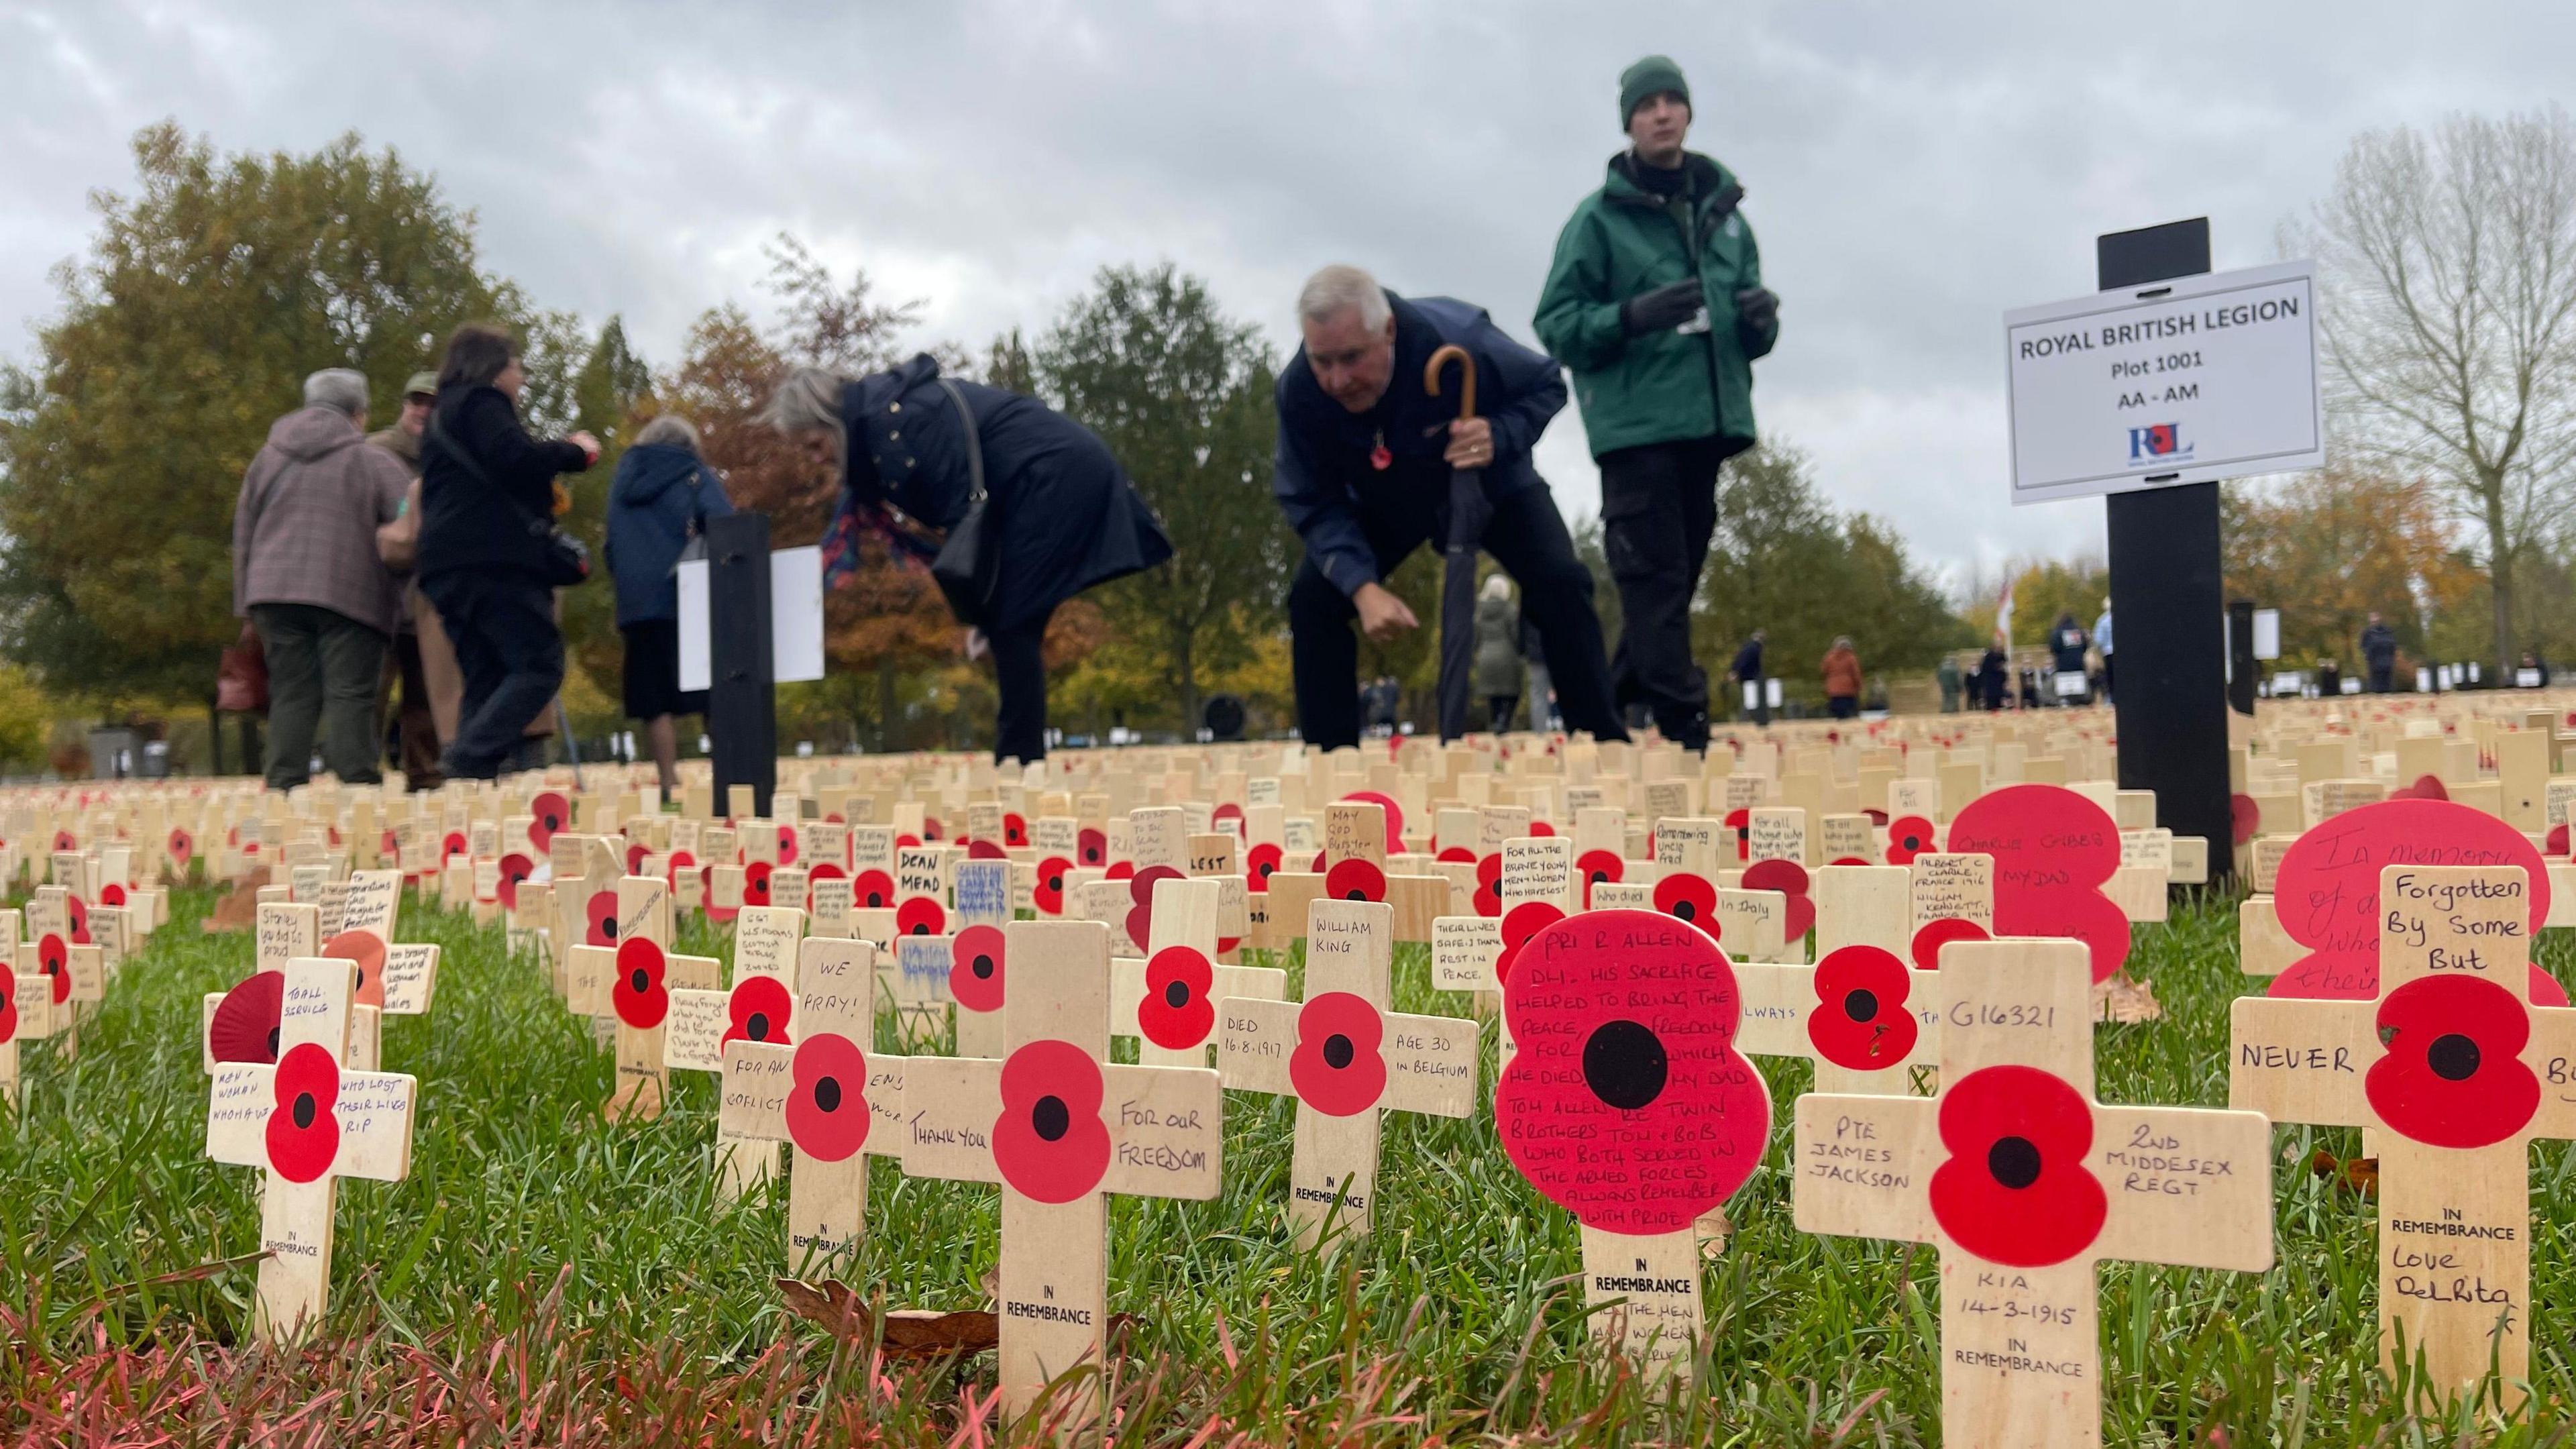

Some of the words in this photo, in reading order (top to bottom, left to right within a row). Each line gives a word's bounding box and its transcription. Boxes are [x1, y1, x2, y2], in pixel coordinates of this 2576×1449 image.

[2021, 332, 2094, 360] ROYAL
[2103, 315, 2195, 347] BRITISH
[2205, 298, 2298, 331] LEGION
[2112, 361, 2149, 379] Plot
[2156, 351, 2203, 372] 1001
[2118, 392, 2145, 410] AA
[2164, 384, 2198, 403] AM
[1332, 810, 1359, 821] MAY
[1507, 847, 1525, 857] FOR
[1528, 847, 1543, 855] ALL
[1544, 846, 1562, 854] THE
[1658, 843, 1684, 853] Uncle
[900, 852, 938, 869] DEAN
[1190, 856, 1226, 870] LEST
[1505, 861, 1538, 872] BRAVE
[1540, 861, 1567, 872] YOUNG
[1921, 857, 1966, 867] ALBERT
[902, 875, 940, 892] MEAD
[1505, 876, 1523, 885] MEN
[1532, 873, 1566, 883] WOMEN
[1915, 877, 1954, 887] FRANCE
[1963, 875, 1984, 885] 1916
[2003, 870, 2031, 888] MY
[2033, 869, 2070, 887] DAD
[1505, 889, 1523, 897] WHO
[1524, 888, 1546, 896] HAVE
[1547, 885, 1566, 894] LOST
[1620, 890, 1644, 902] died
[1917, 894, 1962, 902] WILLIAM
[2396, 875, 2521, 912] Forgotten
[1722, 900, 1733, 909] In
[1316, 918, 1371, 935] WILLIAM
[1437, 924, 1464, 933] THEIR
[1466, 922, 1495, 932] LIVES
[2388, 912, 2425, 947] By
[1316, 942, 1351, 954] KING
[1596, 931, 1609, 949] R
[1623, 930, 1693, 948] ALLEN
[1440, 955, 1468, 964] REST
[2429, 949, 2487, 970] But
[820, 961, 851, 976] WE
[1591, 968, 1618, 982] HIS
[1628, 963, 1717, 981] SACRIFICE
[578, 977, 597, 987] THE
[1515, 994, 1589, 1010] HELPED
[1596, 993, 1618, 1007] TO
[1628, 991, 1689, 1009] BRING
[1693, 989, 1730, 1004] THE
[1745, 1007, 1796, 1018] LWAYS
[1949, 1001, 2053, 1028] G16321
[1228, 1018, 1258, 1032] DIED
[1652, 1014, 1731, 1038] FREEDOM
[1226, 1038, 1281, 1059] 16.8.1917
[1397, 1034, 1425, 1051] AGE
[1432, 1037, 1450, 1051] 30
[1536, 1041, 1579, 1058] FOR
[1664, 1048, 1726, 1064] WHICH
[2242, 1044, 2355, 1073] NEVER
[736, 1059, 761, 1075] FOR
[768, 1060, 789, 1076] AN
[1397, 1062, 1407, 1071] IN
[1414, 1061, 1468, 1077] BELGIUM
[341, 1081, 364, 1091] WHO
[370, 1078, 402, 1093] LOST
[1510, 1070, 1534, 1084] HE
[1672, 1071, 1699, 1086] MY
[1709, 1069, 1748, 1085] DAD
[337, 1100, 372, 1114] THEIR
[1121, 1100, 1159, 1127] FOR
[1509, 1097, 1542, 1114] TOM
[1554, 1101, 1608, 1116] ALLEN
[1663, 1093, 1725, 1118] TWIN
[345, 1118, 371, 1134] RIP
[910, 1110, 955, 1146] THANK
[957, 1127, 987, 1149] YOU
[1511, 1118, 1597, 1139] BROTHERS
[1606, 1129, 1650, 1144] TOM
[1674, 1123, 1717, 1143] BOB
[1836, 1115, 1876, 1140] PTE
[2128, 1124, 2180, 1150] 2ND
[1118, 1142, 1206, 1172] FREEDOM
[1523, 1145, 1566, 1161] WHO
[1577, 1145, 1625, 1163] BOTH
[1633, 1148, 1702, 1163] SERVED
[1711, 1139, 1735, 1158] IN
[1811, 1144, 1891, 1164] JAMES
[2107, 1152, 2233, 1177] MIDDESEX
[1326, 1176, 1334, 1187] IN
[1532, 1168, 1568, 1183] THE
[1576, 1169, 1628, 1183] ARMED
[1810, 1165, 1909, 1189] JACKSON
[2124, 1173, 2199, 1195] REGT
[1296, 1187, 1364, 1208] REMEMBRNCE
[1565, 1189, 1635, 1202] ALWAYS
[1640, 1183, 1723, 1201] REMEMBER
[1585, 1210, 1625, 1224] WITH
[1631, 1210, 1683, 1226] PRIDE
[2443, 1208, 2461, 1220] IN
[288, 1231, 297, 1241] IN
[820, 1224, 827, 1234] IN
[2392, 1220, 2514, 1240] REMEMBRANCE
[266, 1240, 317, 1256] REMEMBRANCE
[1635, 1258, 1646, 1271] IN
[1596, 1277, 1691, 1293] REMEMBRANCE
[1978, 1273, 2028, 1290] KIA
[1044, 1285, 1053, 1299] IN
[1007, 1301, 1091, 1326] REMEMBRANCE
[1627, 1303, 1655, 1316] THE
[1960, 1299, 2076, 1325] 14-3-1915
[2008, 1339, 2026, 1352] IN
[1955, 1351, 2082, 1377] REMEMBRANCE
